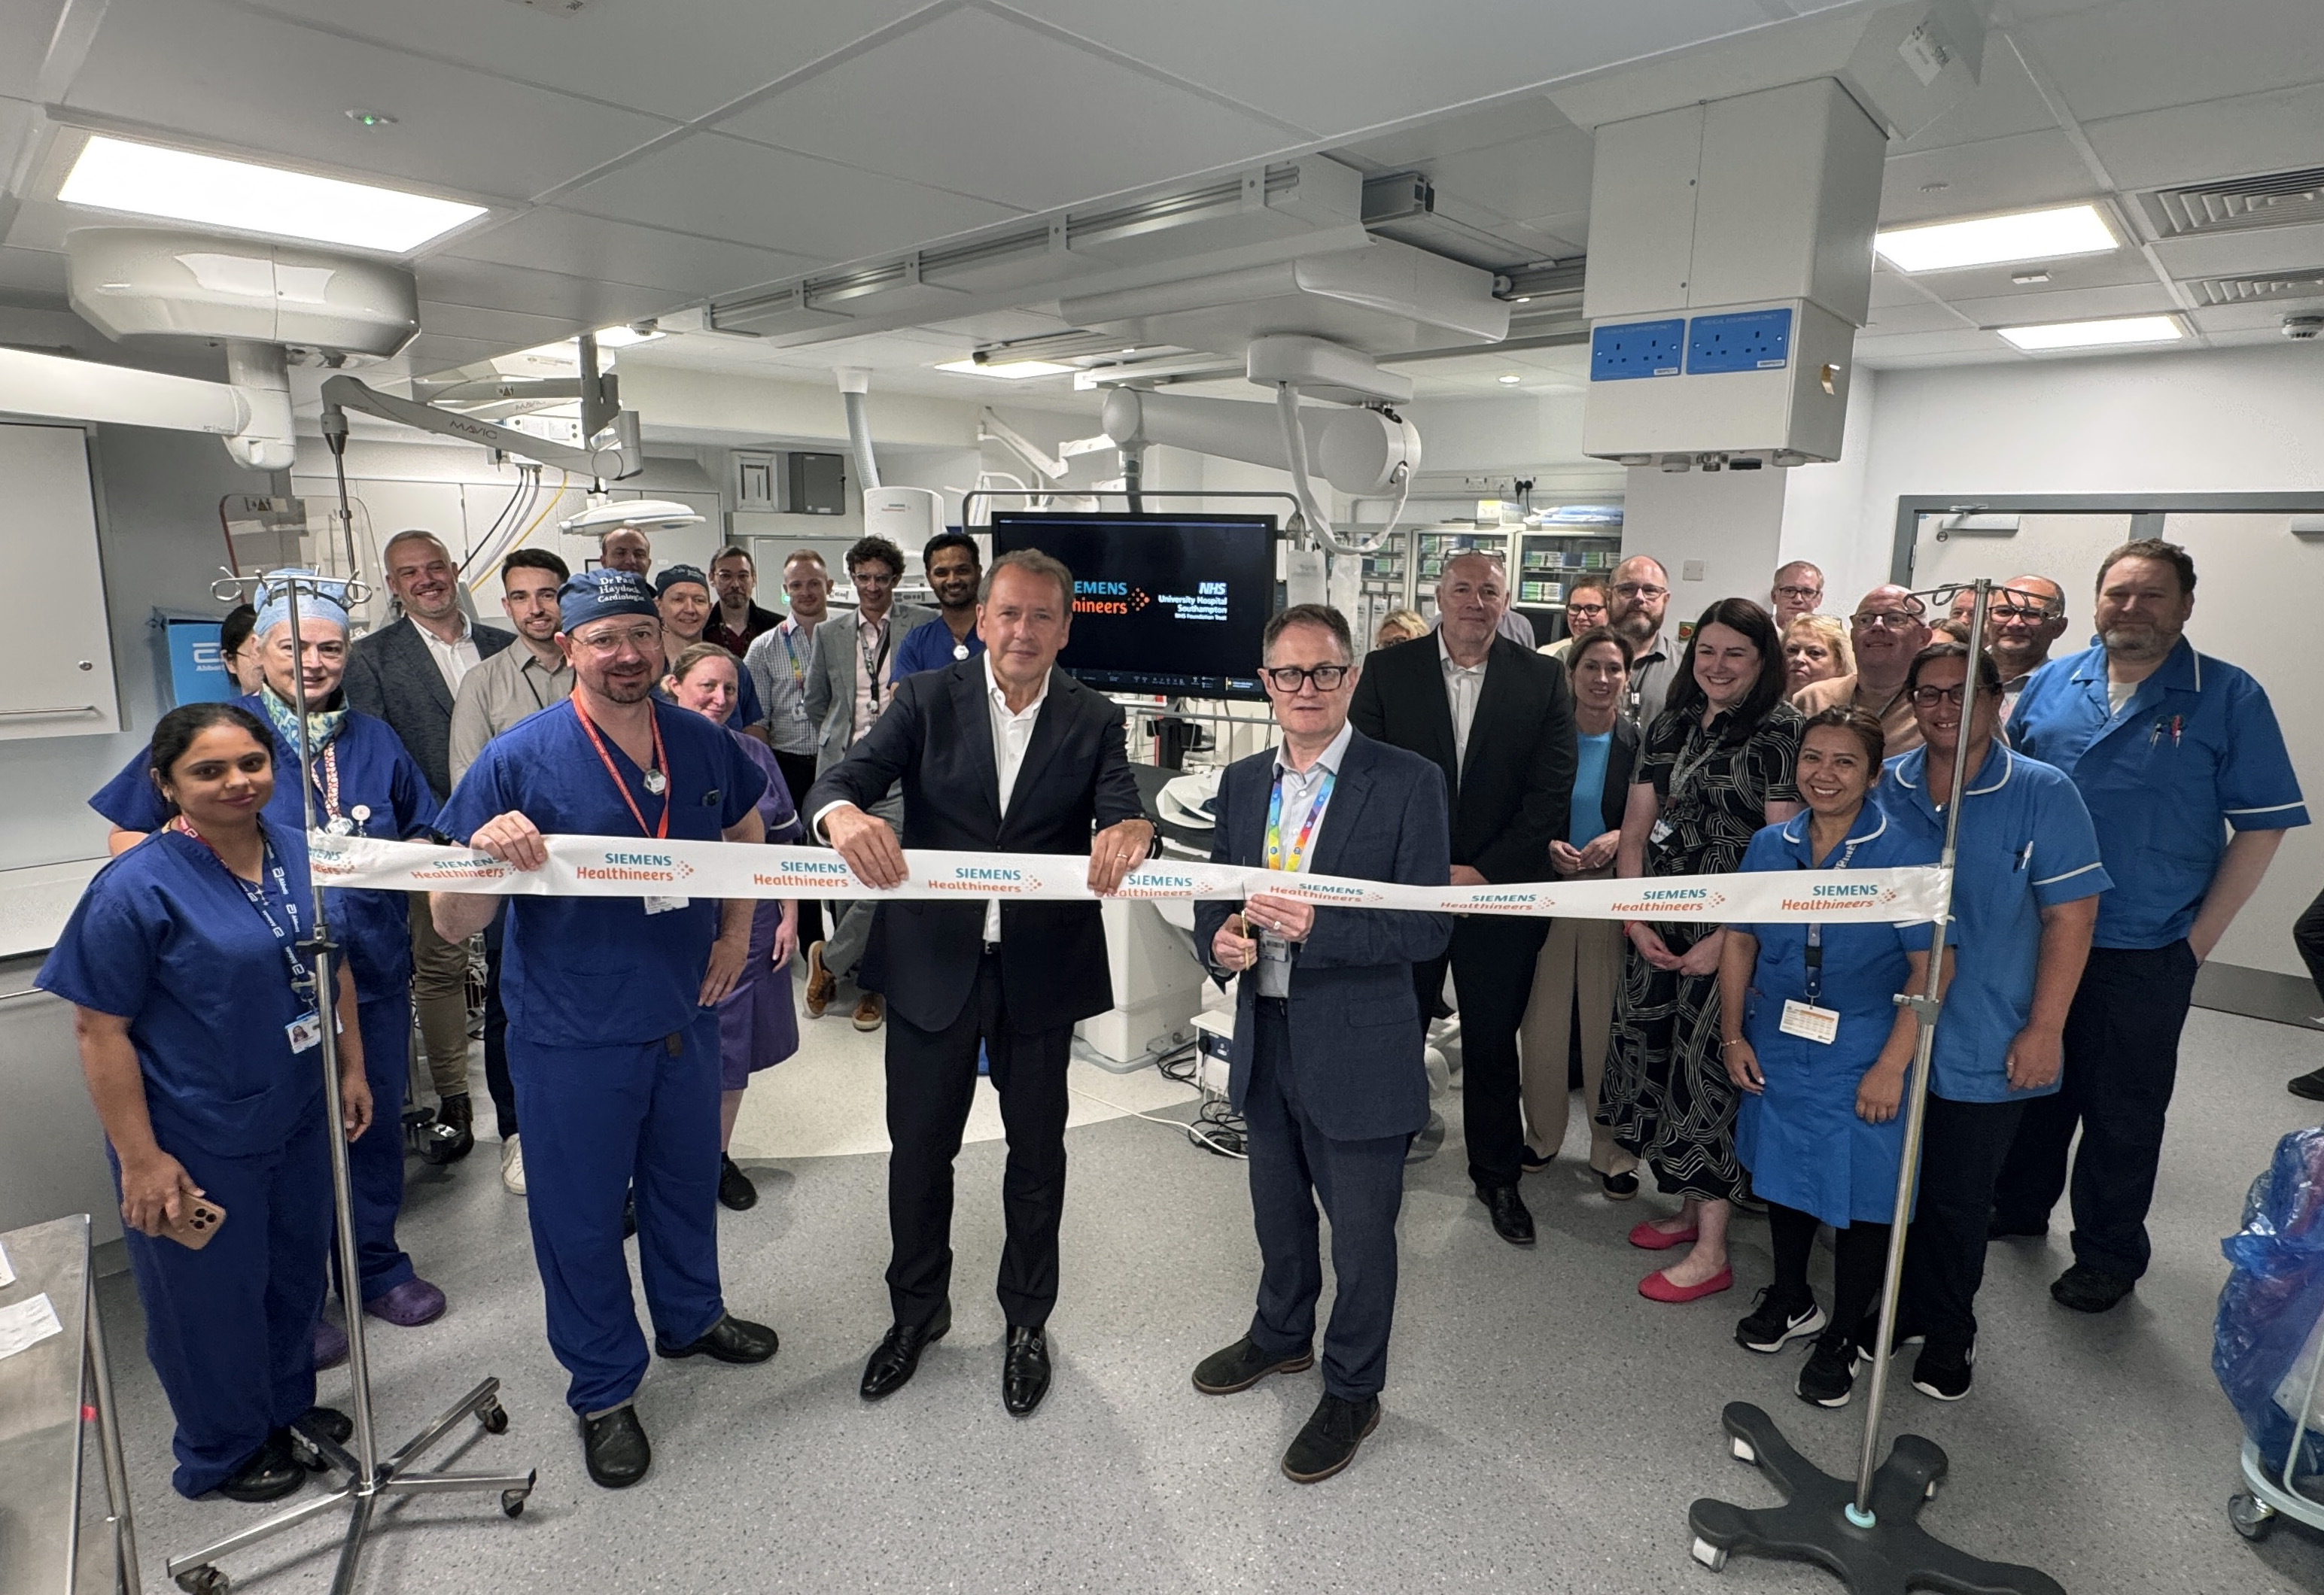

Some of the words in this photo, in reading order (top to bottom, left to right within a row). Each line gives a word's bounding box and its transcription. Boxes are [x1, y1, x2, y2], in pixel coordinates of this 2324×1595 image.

[615, 576, 635, 585] Paul
[1074, 581, 1127, 595] EMENS
[1199, 582, 1227, 595] NHS
[1072, 597, 1127, 614] hineers
[1158, 594, 1195, 605] University
[1197, 597, 1227, 606] Hospital
[1177, 604, 1227, 614] Southampton
[605, 852, 672, 867] SIEMENS
[780, 861, 847, 873] SIEMENS
[412, 868, 504, 879] Healthineers
[576, 866, 674, 882] Healthineers
[955, 867, 1021, 880] SIEMENS
[753, 873, 849, 888] Healthineers
[928, 880, 1021, 893] Healthineers
[1128, 874, 1193, 887] SIEMENS
[1270, 886, 1362, 903] Healthineers
[1299, 883, 1364, 895] SIEMENS
[1642, 889, 1707, 900] SIEMENS
[1812, 884, 1878, 896] SIEMENS
[1471, 894, 1537, 902] SIEMENS
[1440, 902, 1533, 911] Healthineers
[1611, 902, 1703, 912] Healthineers
[1781, 899, 1875, 910] Healthineers
